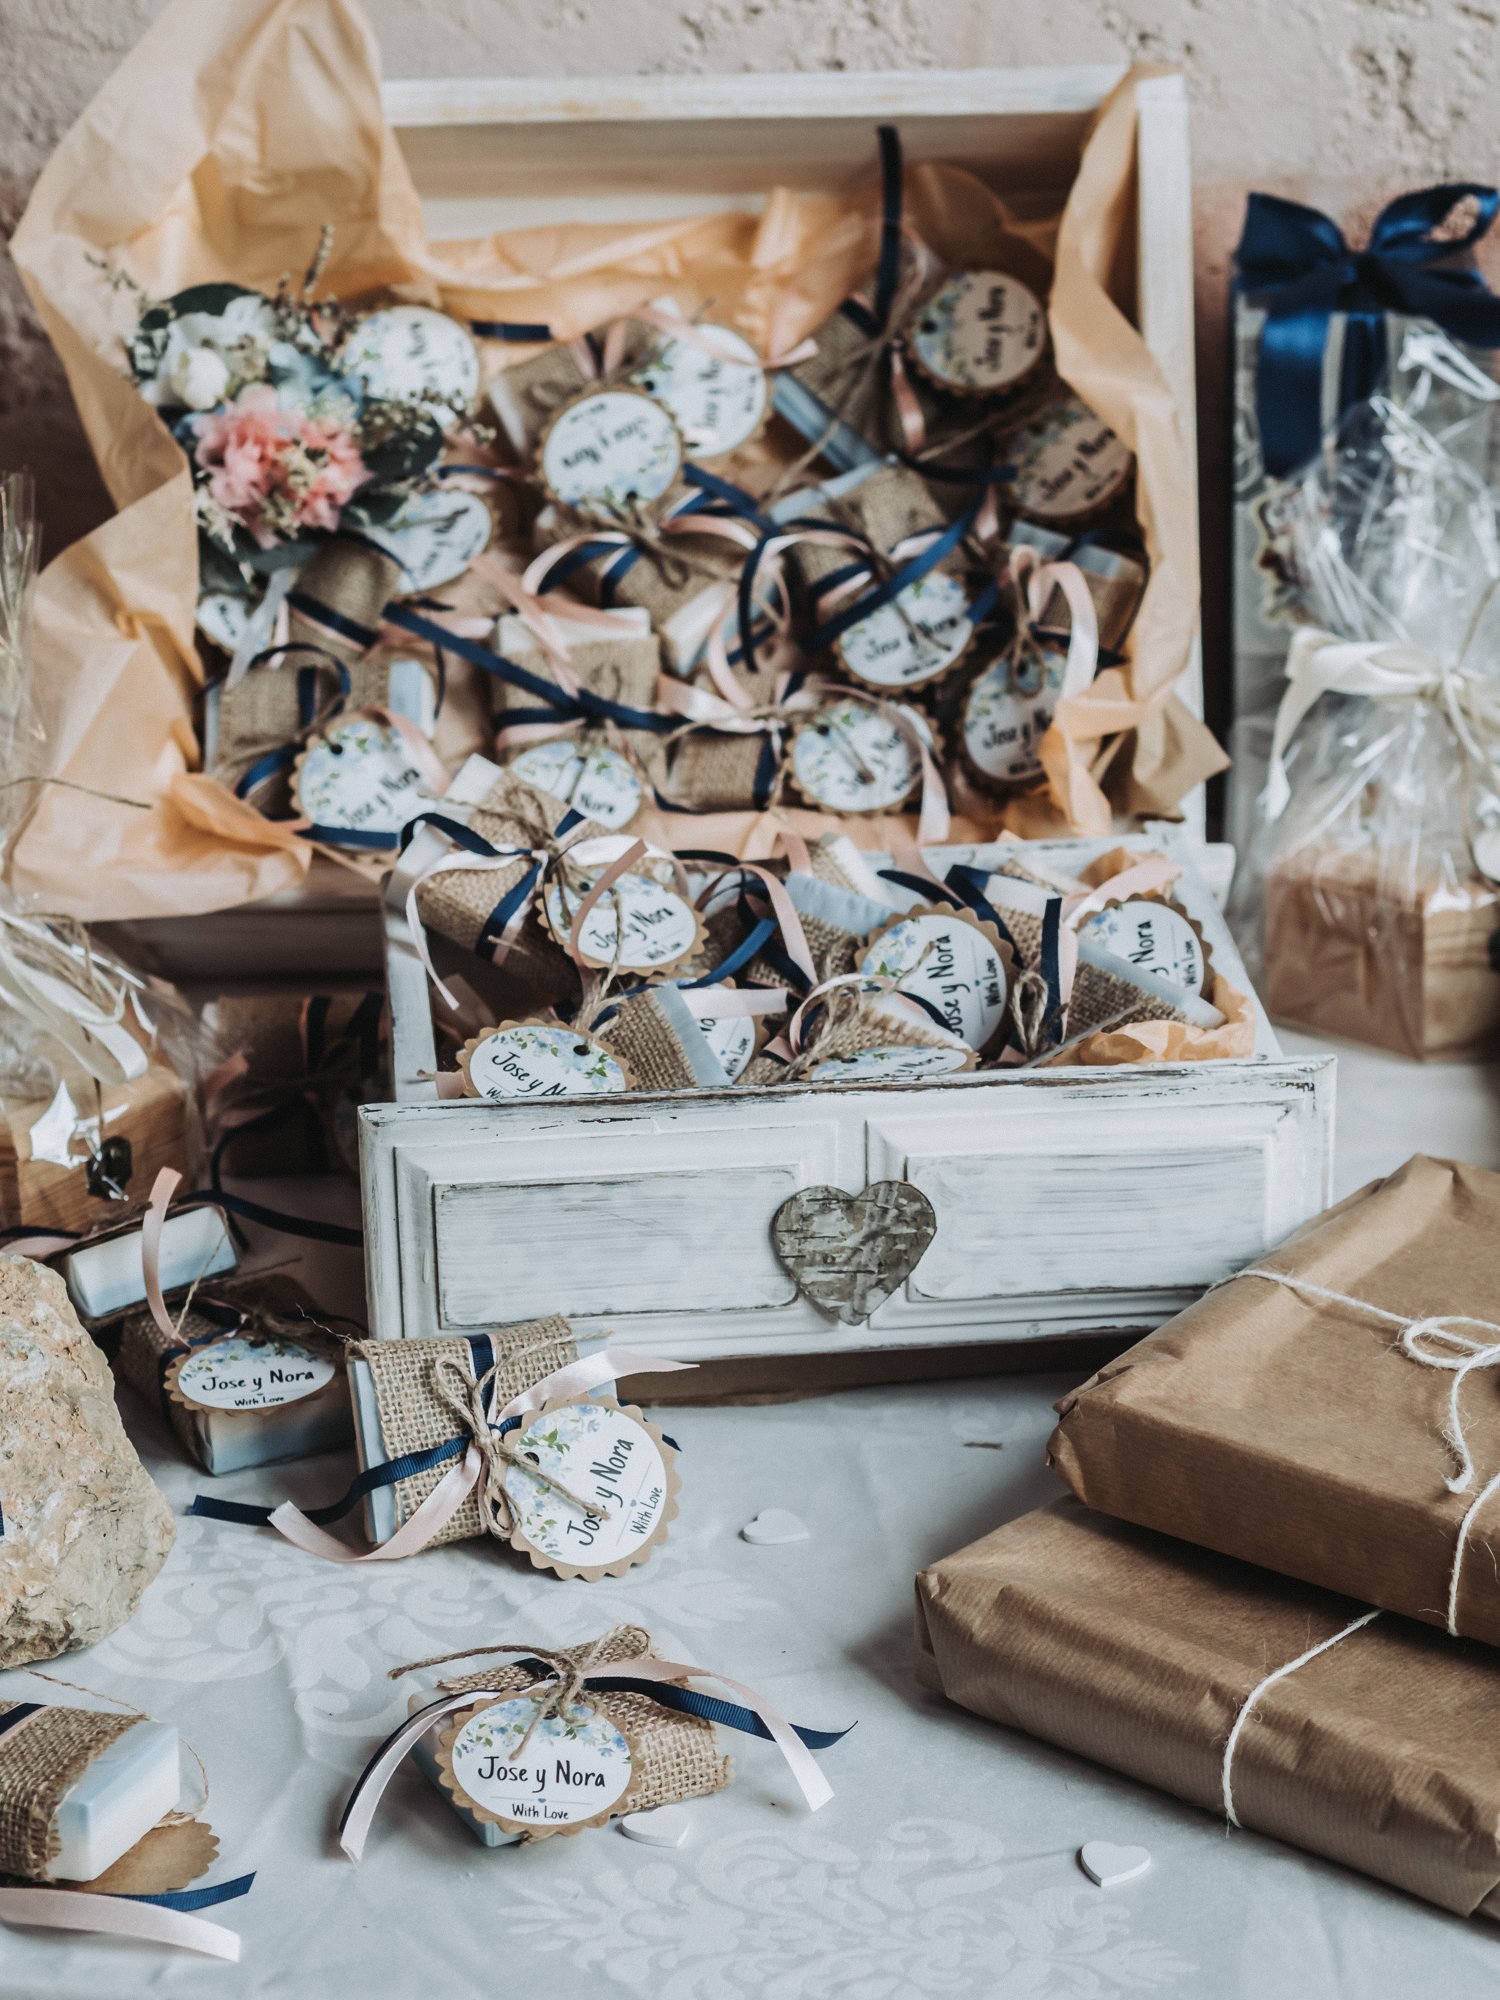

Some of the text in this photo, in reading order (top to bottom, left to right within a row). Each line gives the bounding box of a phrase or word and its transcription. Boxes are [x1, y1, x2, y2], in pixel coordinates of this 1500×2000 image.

[926, 934, 955, 980] Nora
[1127, 920, 1155, 964] Nora
[940, 983, 971, 995] y
[491, 1051, 531, 1082] Jose
[516, 1078, 544, 1093] y
[202, 1369, 315, 1393] Jose y Nora
[234, 1395, 285, 1407] With Love
[589, 1438, 635, 1483] Nora
[595, 1485, 624, 1509] y
[629, 1487, 663, 1535] With Love
[477, 1755, 606, 1794] Jose y Nora
[511, 1803, 570, 1820] With Love
